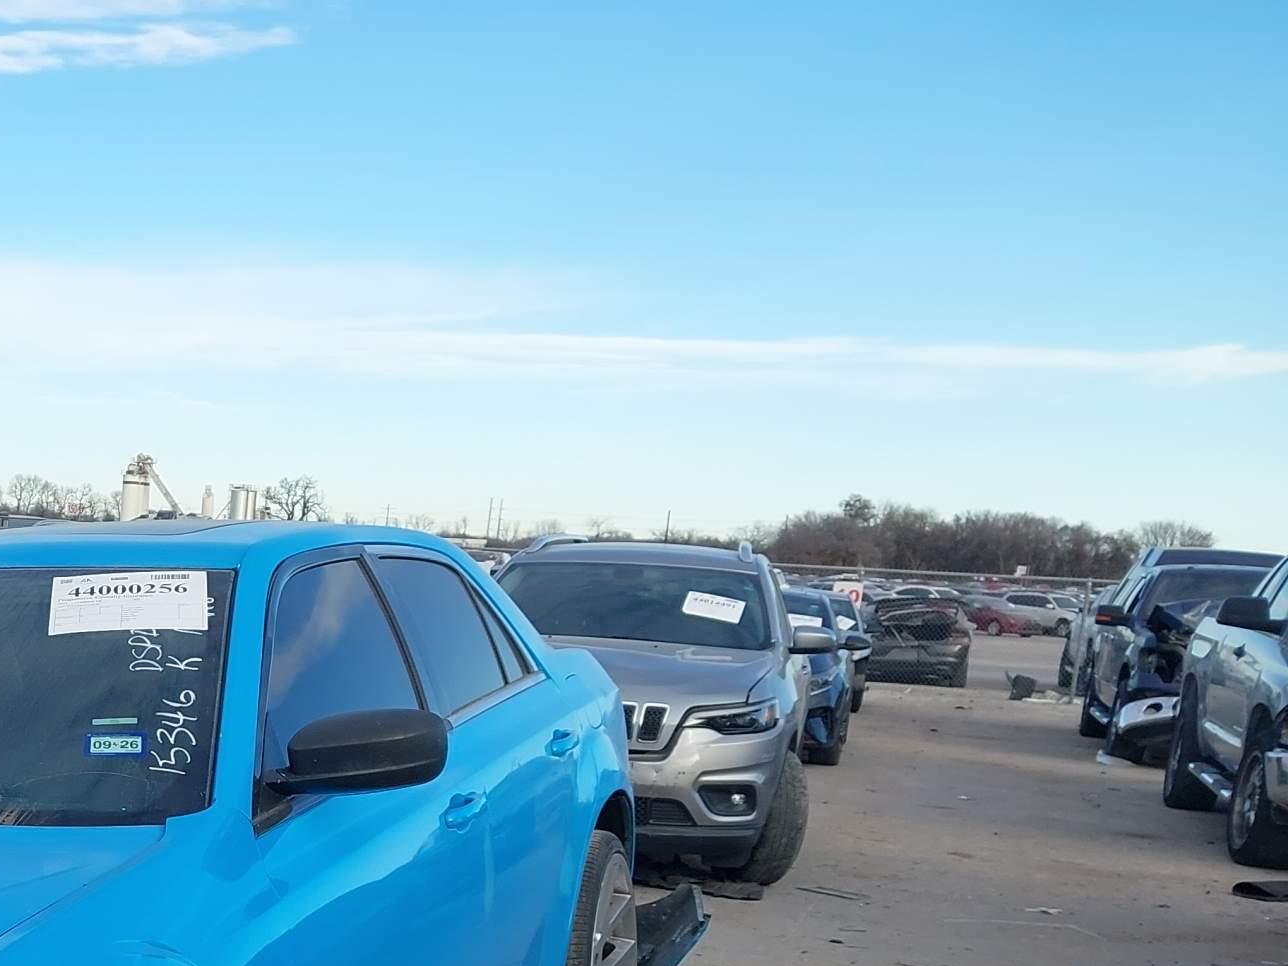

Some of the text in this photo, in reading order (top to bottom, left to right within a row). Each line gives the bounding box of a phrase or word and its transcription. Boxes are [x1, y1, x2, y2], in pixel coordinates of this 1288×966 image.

[68, 583, 188, 598] 44000256
[166, 655, 203, 671] K
[149, 690, 198, 775] 15346
